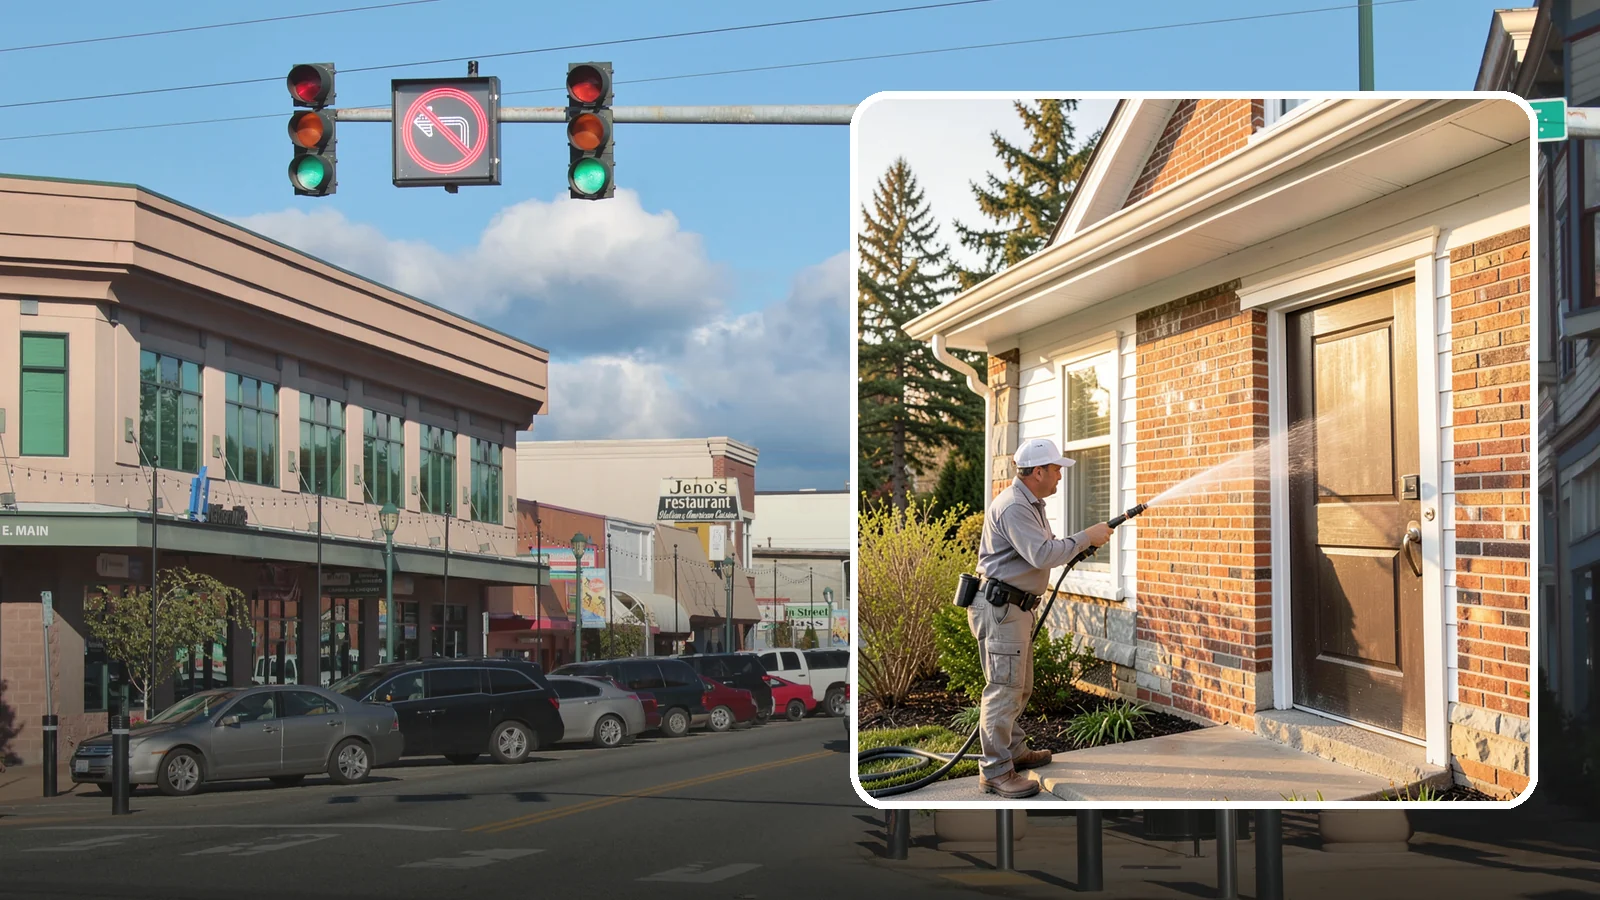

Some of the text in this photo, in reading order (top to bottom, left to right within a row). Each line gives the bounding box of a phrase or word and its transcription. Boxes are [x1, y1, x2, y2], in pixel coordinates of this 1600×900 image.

[669, 480, 727, 495] Jeno's
[665, 496, 731, 509] restaurant
[659, 510, 681, 519] Italian
[686, 509, 714, 519] American
[715, 509, 737, 519] Cuisine
[2, 525, 49, 536] E. MAIN
[797, 607, 828, 617] Street
